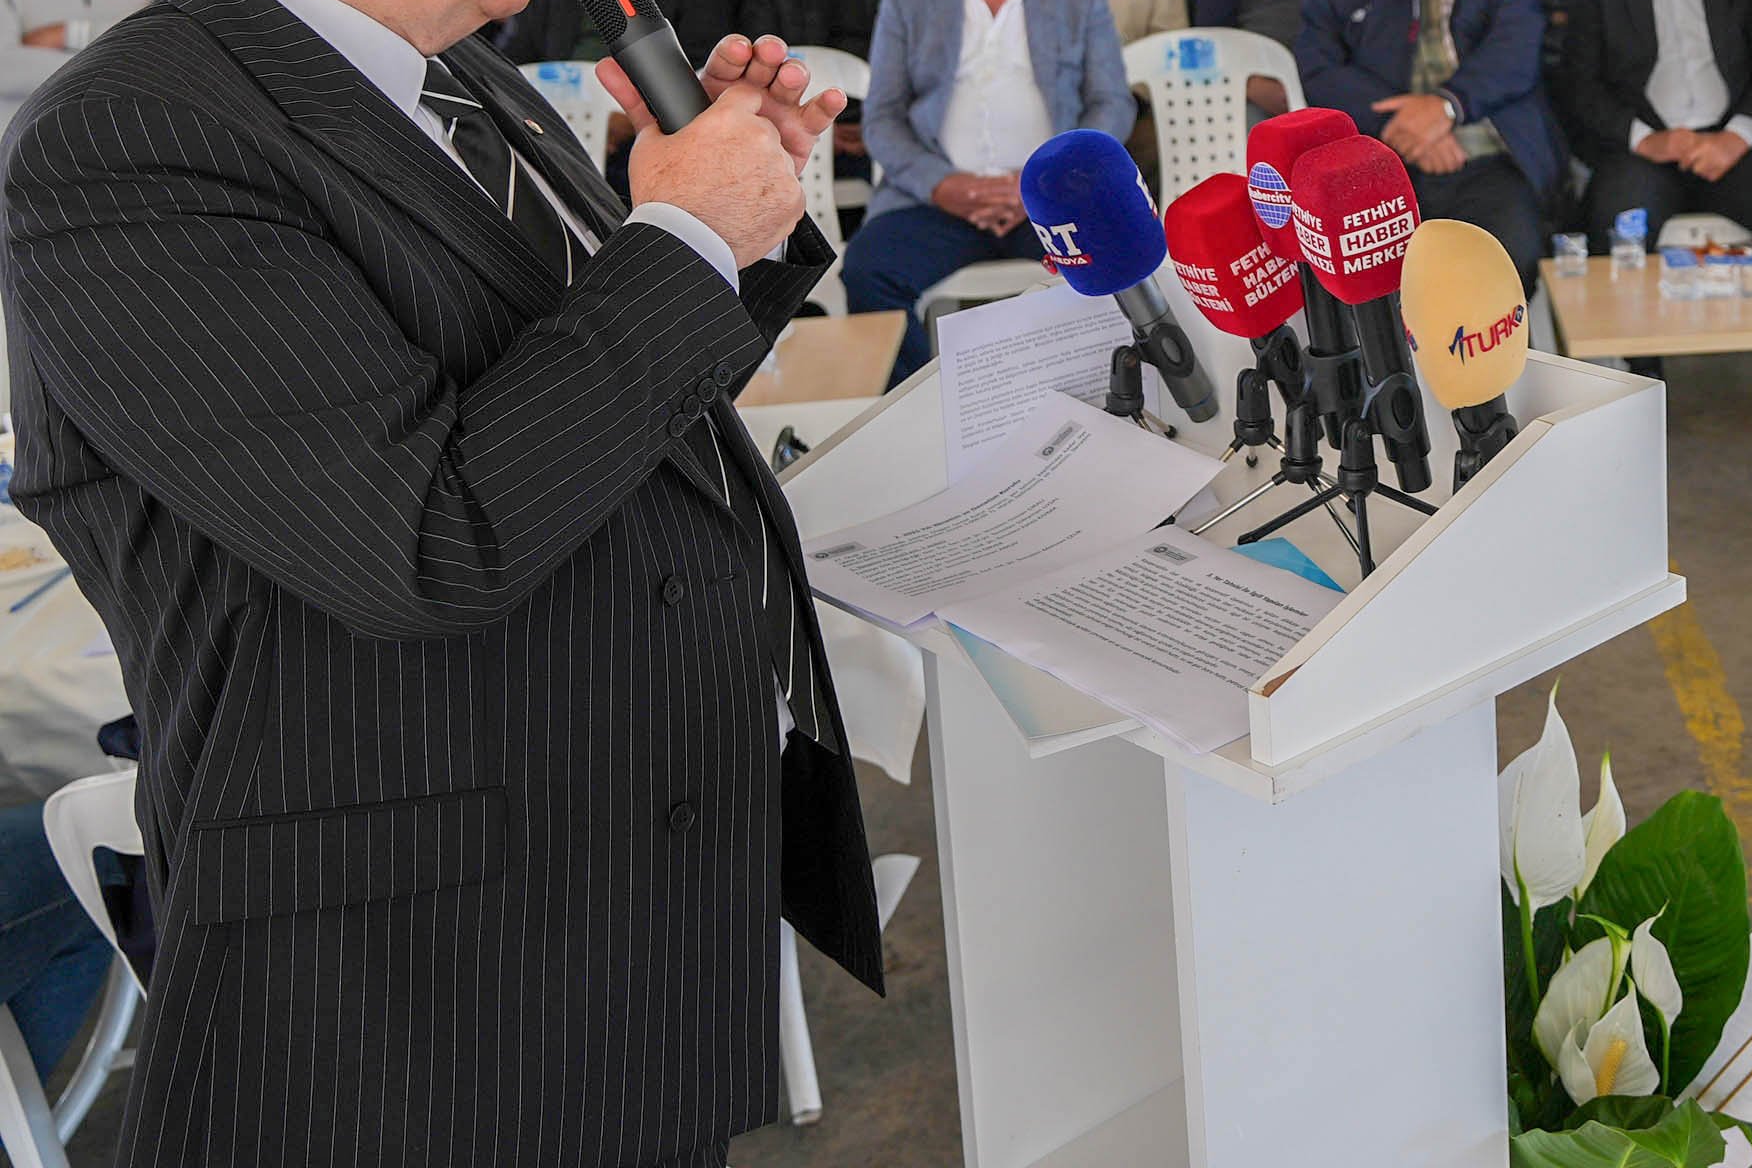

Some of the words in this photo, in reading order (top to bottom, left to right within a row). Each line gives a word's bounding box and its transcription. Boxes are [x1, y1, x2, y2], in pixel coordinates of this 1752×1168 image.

[1343, 196, 1407, 230] FETHİYE
[1295, 224, 1327, 253] ABER
[1347, 218, 1410, 252] HABER
[1175, 262, 1219, 282] ETHİYE
[1229, 241, 1272, 276] FETH
[1242, 255, 1290, 290] HABE
[1343, 240, 1409, 275] MERKE
[1180, 276, 1221, 298] ABER
[1244, 260, 1300, 307] BÜLTEN
